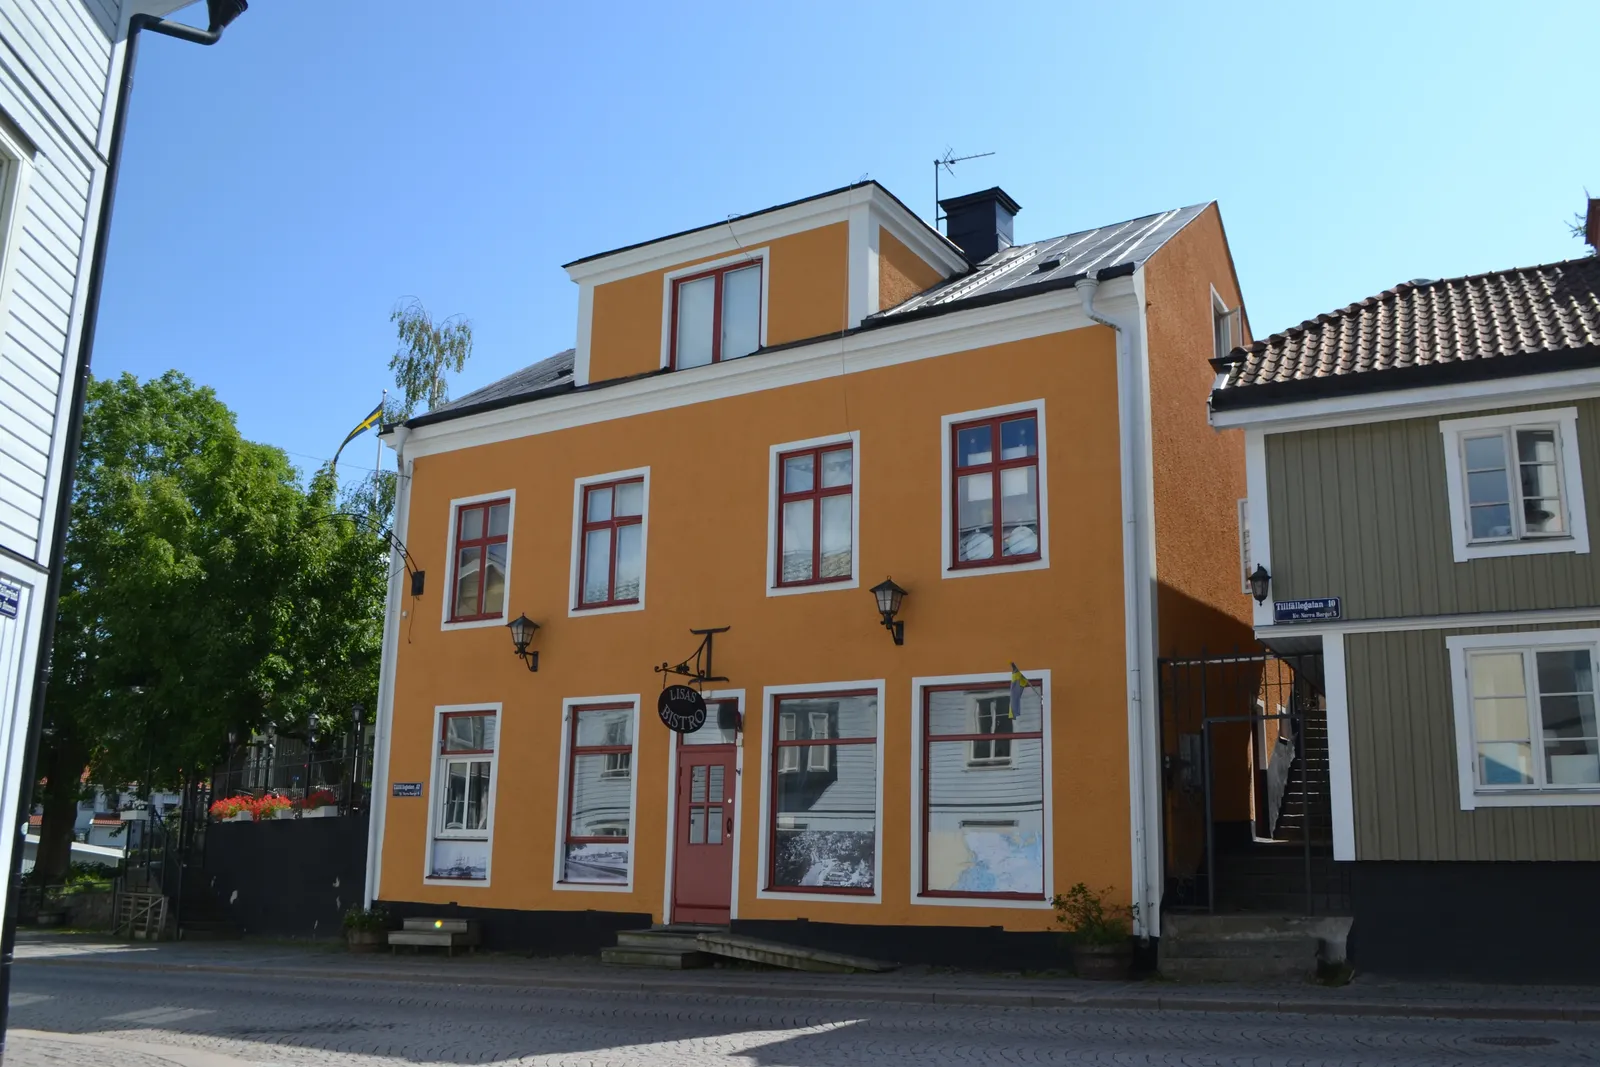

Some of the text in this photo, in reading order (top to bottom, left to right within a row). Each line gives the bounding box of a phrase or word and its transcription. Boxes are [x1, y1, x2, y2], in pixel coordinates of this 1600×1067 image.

[1328, 599, 1336, 607] 10
[669, 688, 697, 703] LISAS
[660, 703, 705, 730] BISTRO
